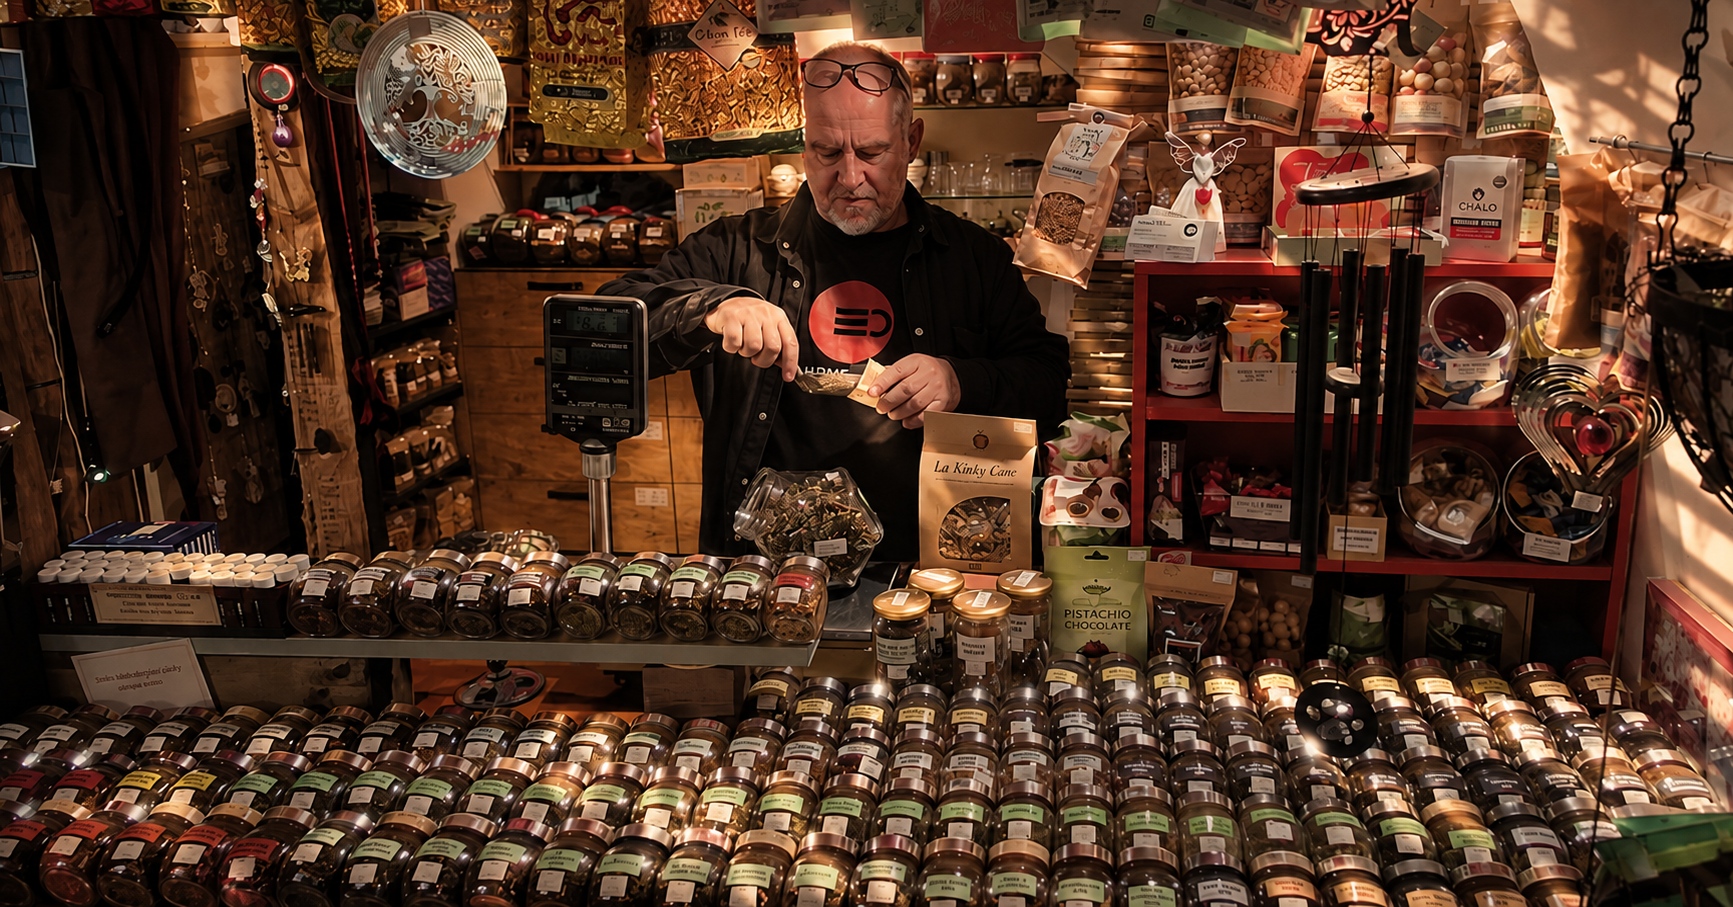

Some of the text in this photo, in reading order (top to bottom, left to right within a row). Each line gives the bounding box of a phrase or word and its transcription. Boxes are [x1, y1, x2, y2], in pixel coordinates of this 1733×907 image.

[1458, 202, 1497, 212] CHALO
[934, 460, 949, 473] La
[953, 462, 986, 479] Kinky
[1064, 609, 1131, 620] PISTACHIO
[1064, 620, 1131, 631] CHOCOLATE
